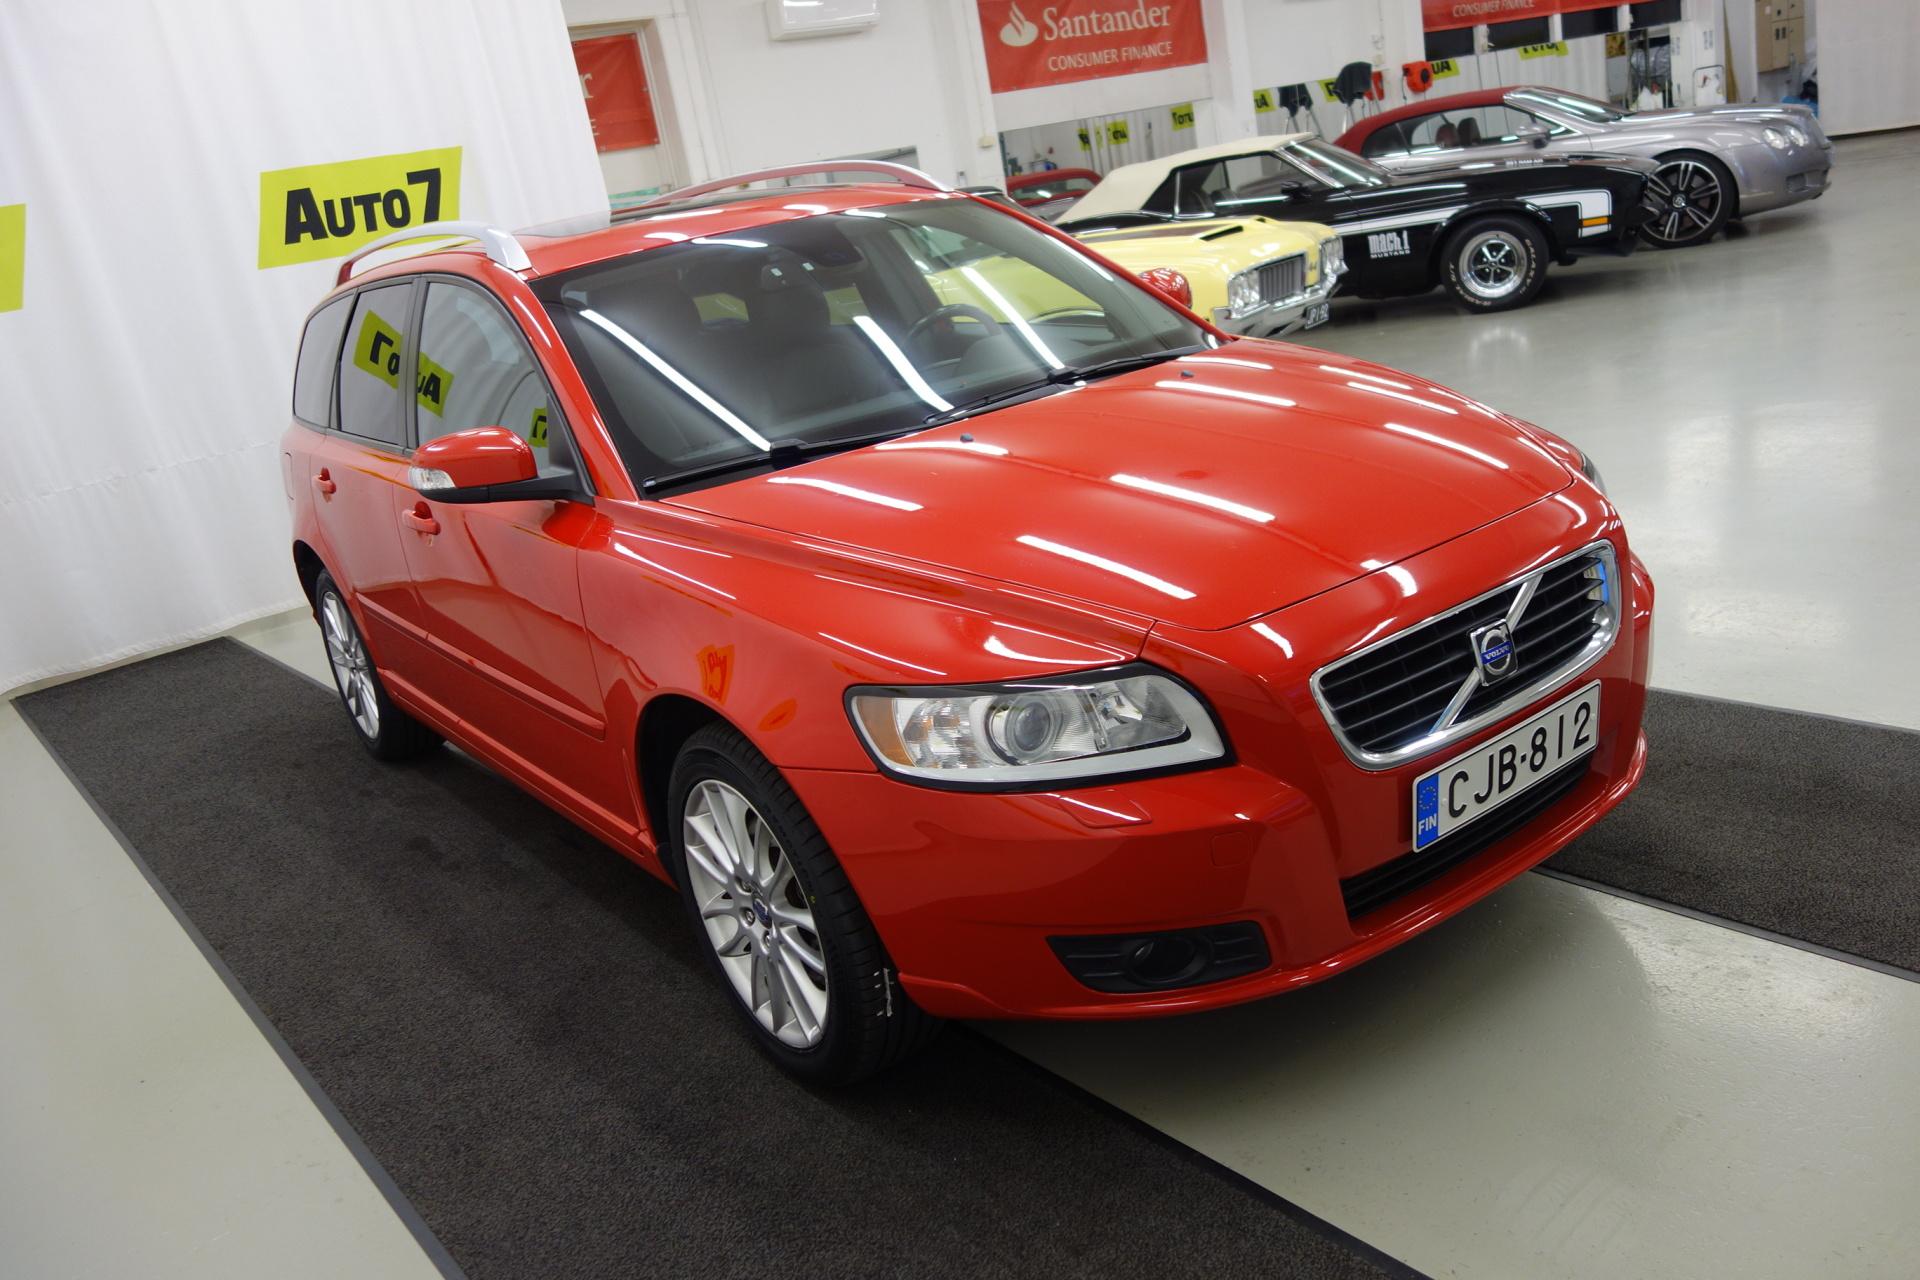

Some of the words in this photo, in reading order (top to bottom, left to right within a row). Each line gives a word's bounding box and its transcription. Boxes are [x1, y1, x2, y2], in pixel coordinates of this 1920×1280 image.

[1042, 0, 1171, 41] Santander
[1453, 1, 1500, 17] CONSUMER
[1048, 48, 1118, 71] CONSUMER
[1121, 41, 1173, 62] FINANCE
[1370, 250, 1410, 258] MUSTANG
[1484, 645, 1510, 660] VOLVO
[1448, 701, 1591, 818] CJB-812
[1418, 813, 1438, 836] FIN
